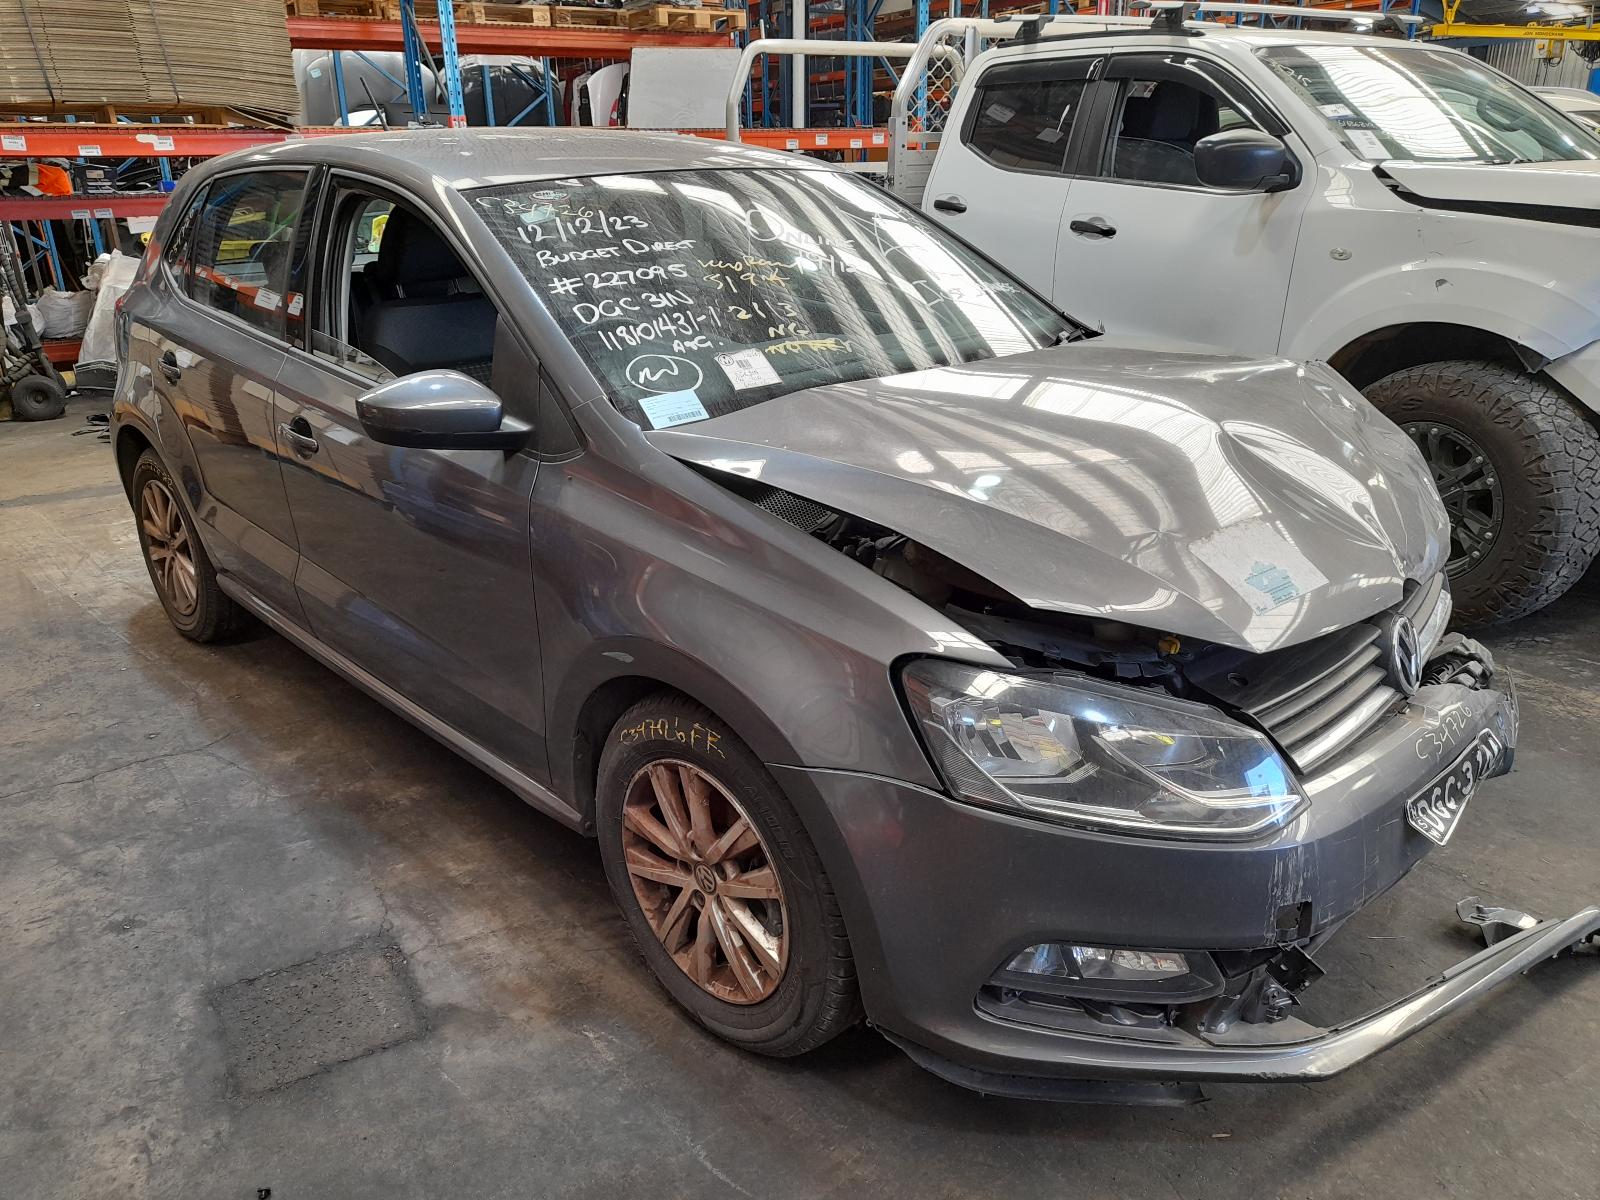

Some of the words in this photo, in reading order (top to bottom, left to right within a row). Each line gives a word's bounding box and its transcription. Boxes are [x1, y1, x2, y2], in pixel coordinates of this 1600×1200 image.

[516, 209, 650, 244] 12/12/23
[535, 246, 621, 268] BUDGET
[622, 238, 697, 255] DIRECT
[548, 263, 688, 295] #227095
[572, 297, 641, 325] DGC
